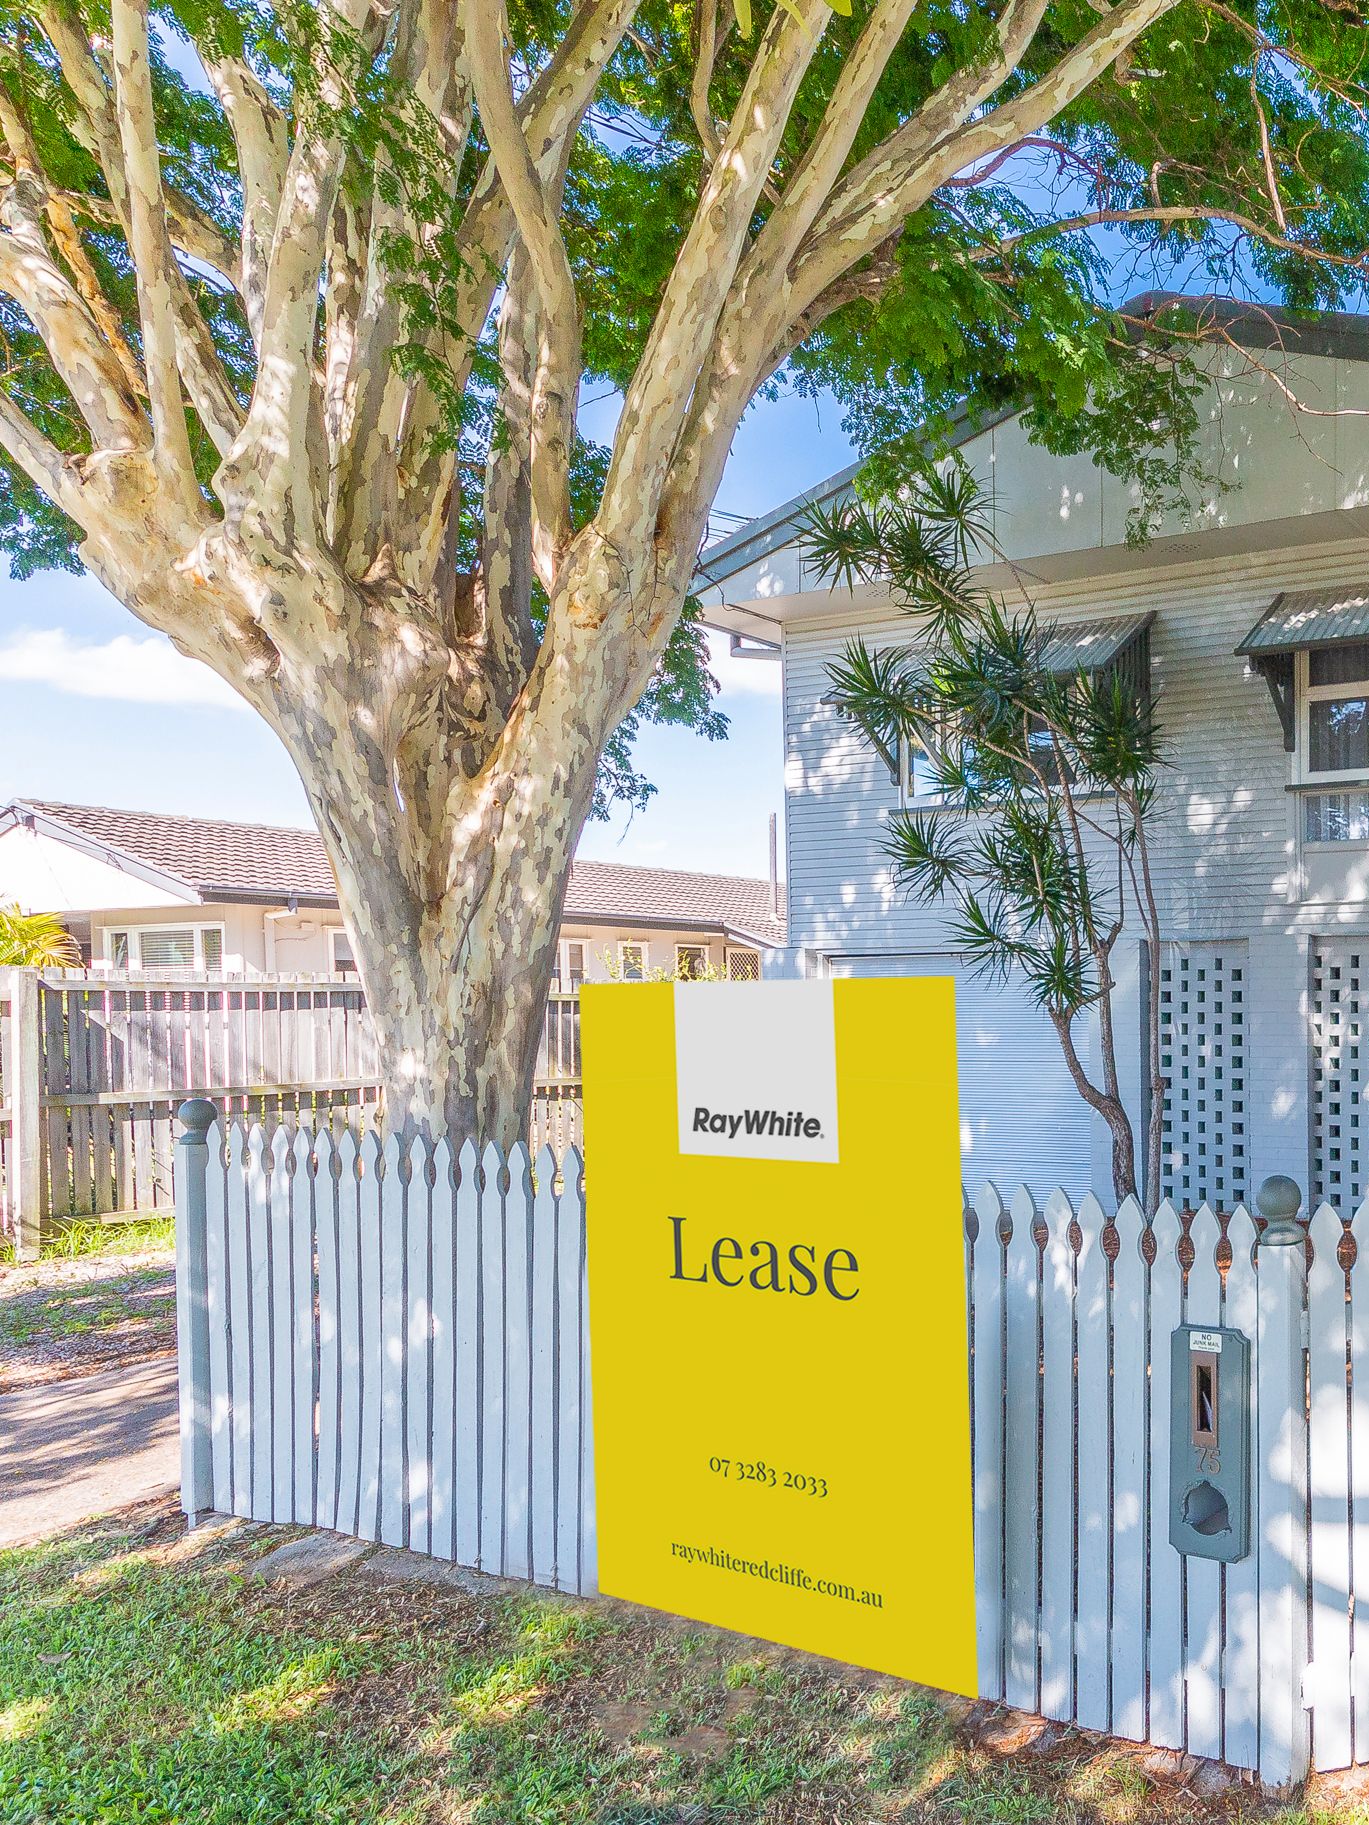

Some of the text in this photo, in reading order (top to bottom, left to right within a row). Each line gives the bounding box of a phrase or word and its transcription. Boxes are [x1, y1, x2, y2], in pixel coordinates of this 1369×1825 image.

[667, 1215, 860, 1302] Lease
[1201, 1333, 1212, 1341] NO
[709, 1456, 829, 1498] 07 3283 2033
[1193, 1447, 1221, 1475] 75
[671, 1541, 884, 1609] raywhiteredcliffe.com.au
